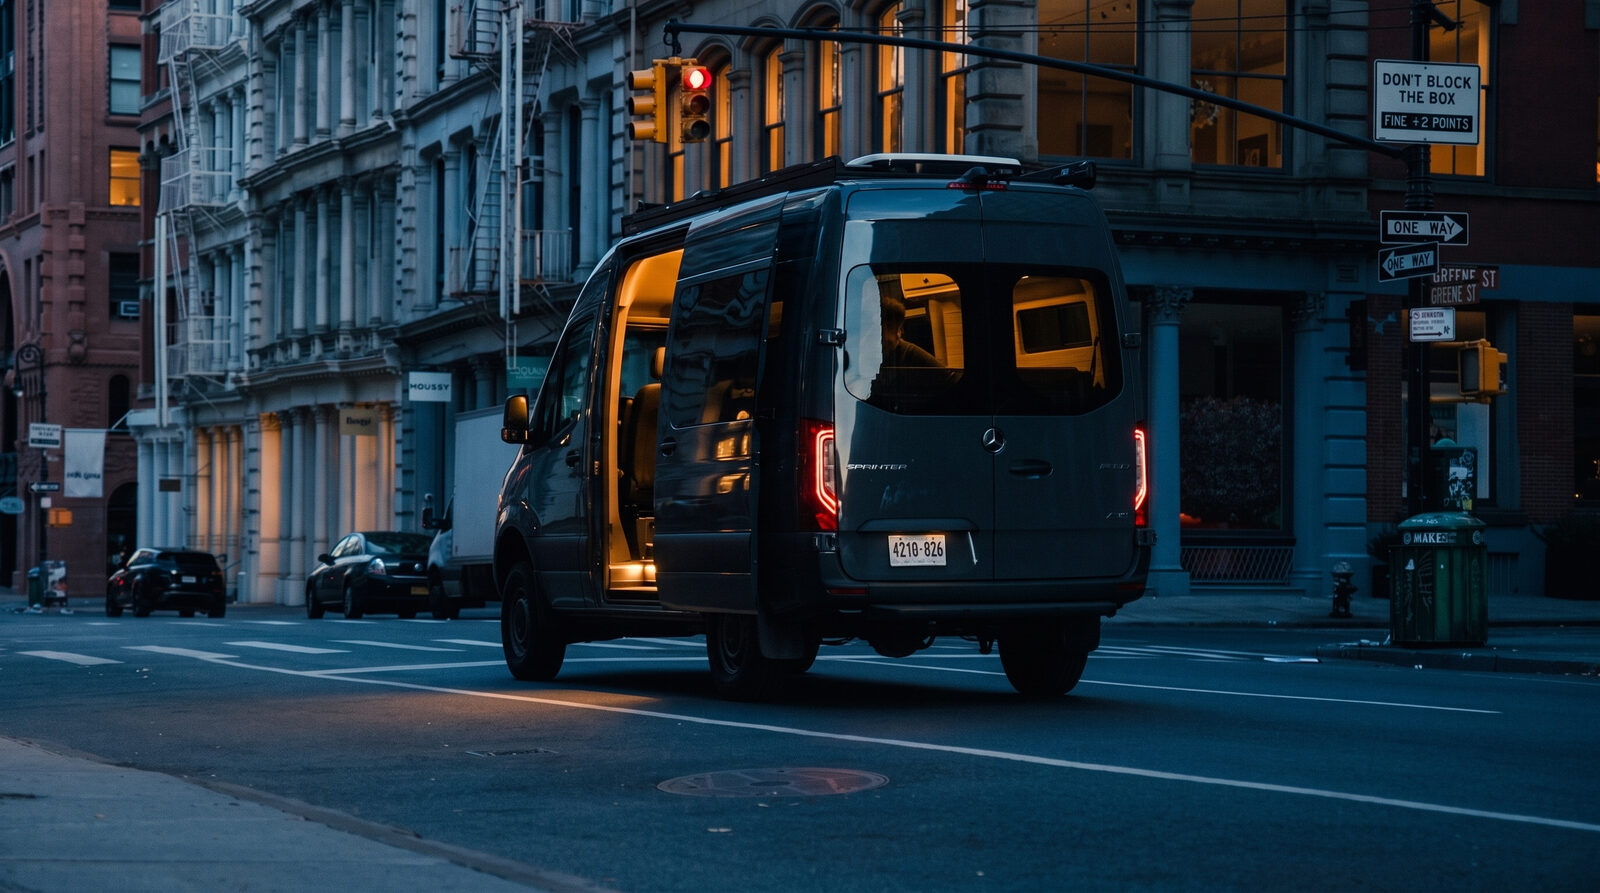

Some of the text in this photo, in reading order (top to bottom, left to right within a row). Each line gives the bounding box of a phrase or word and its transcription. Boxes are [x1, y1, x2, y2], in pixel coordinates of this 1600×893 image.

[1383, 72, 1472, 90] DON'T BLOCK
[1399, 90, 1456, 105] THE BOX
[1384, 114, 1407, 127] FINE
[1432, 117, 1470, 130] POINTS
[1393, 221, 1455, 235] ONE WAY
[1387, 252, 1431, 270] ONE WAY
[1433, 267, 1497, 288] GREENE ST
[1431, 283, 1477, 304] GREENE ST
[410, 383, 450, 391] MOUSSY
